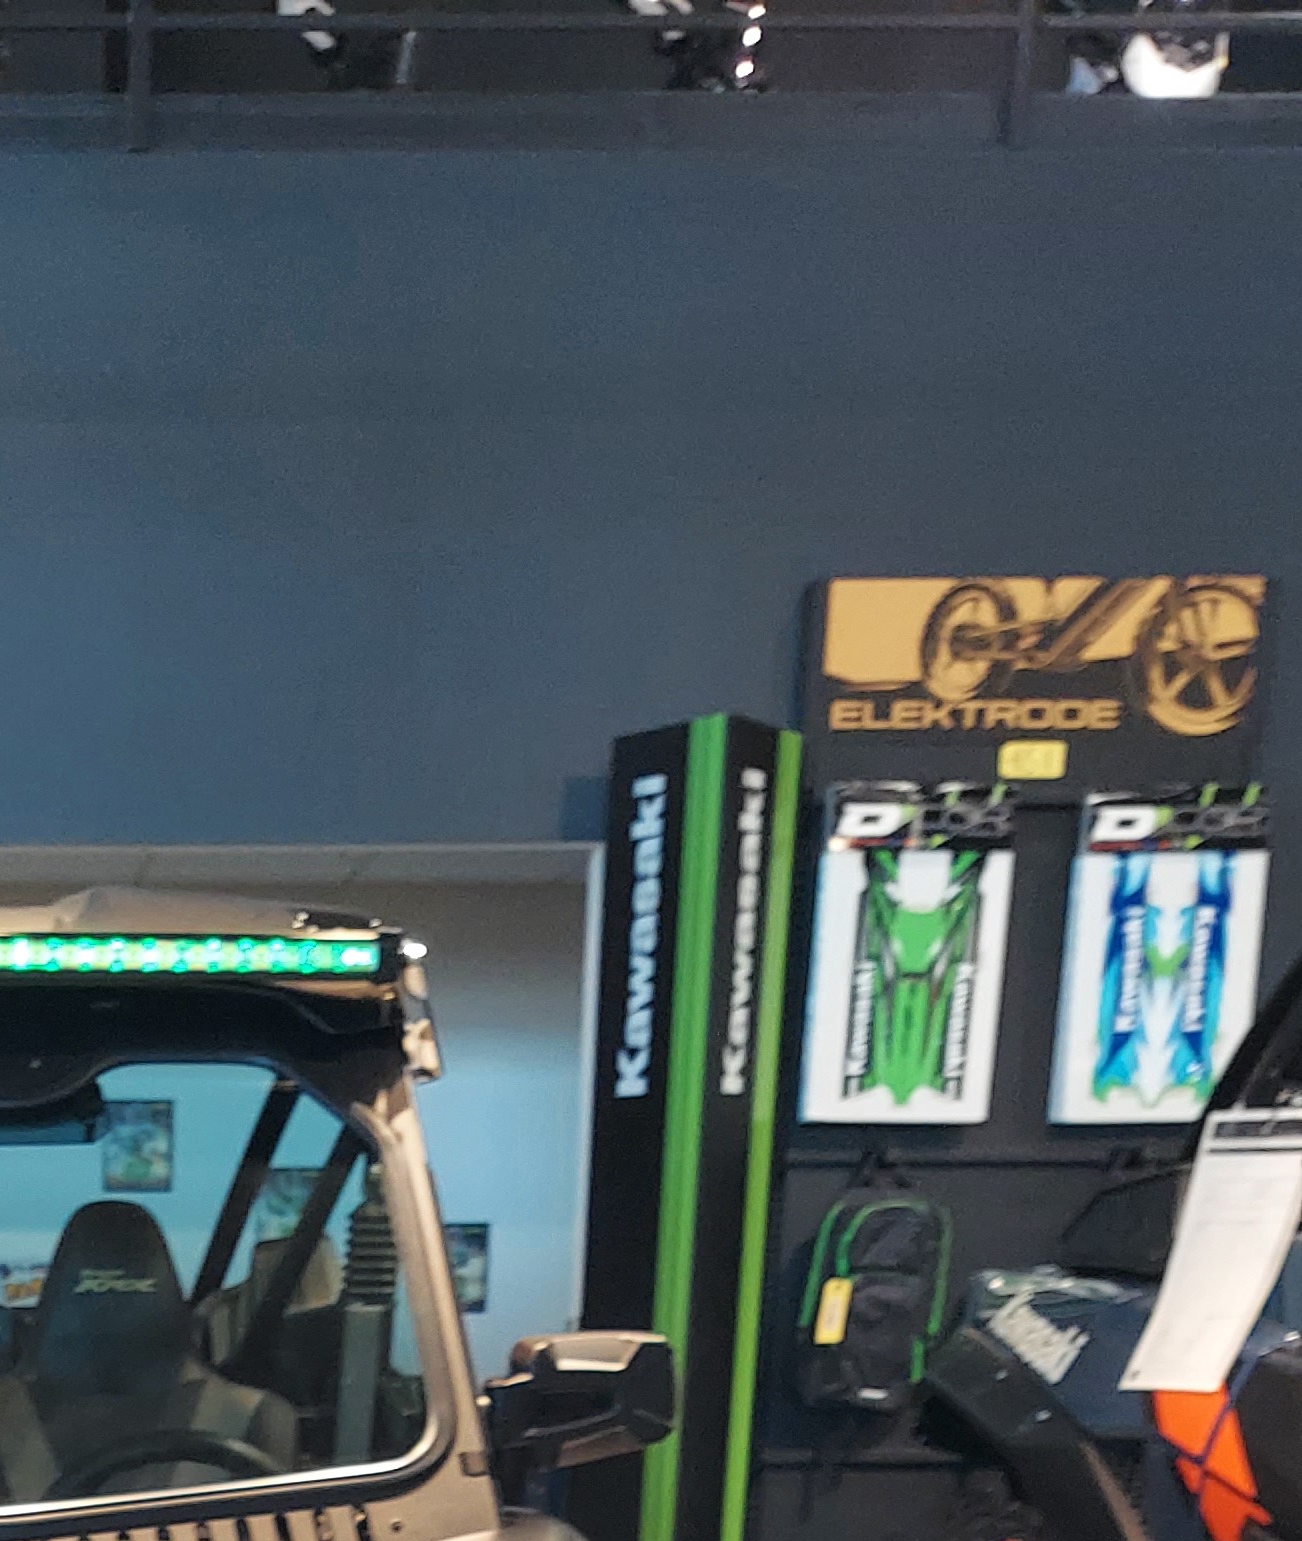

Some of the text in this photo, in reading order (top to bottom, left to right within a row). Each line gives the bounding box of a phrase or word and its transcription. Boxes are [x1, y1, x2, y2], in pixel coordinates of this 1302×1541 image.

[829, 699, 1123, 730] ELEKTRODE
[614, 773, 668, 1098] Kawasaki
[720, 768, 767, 1095] Kawasaki
[1113, 905, 1146, 1033] Kawasaki
